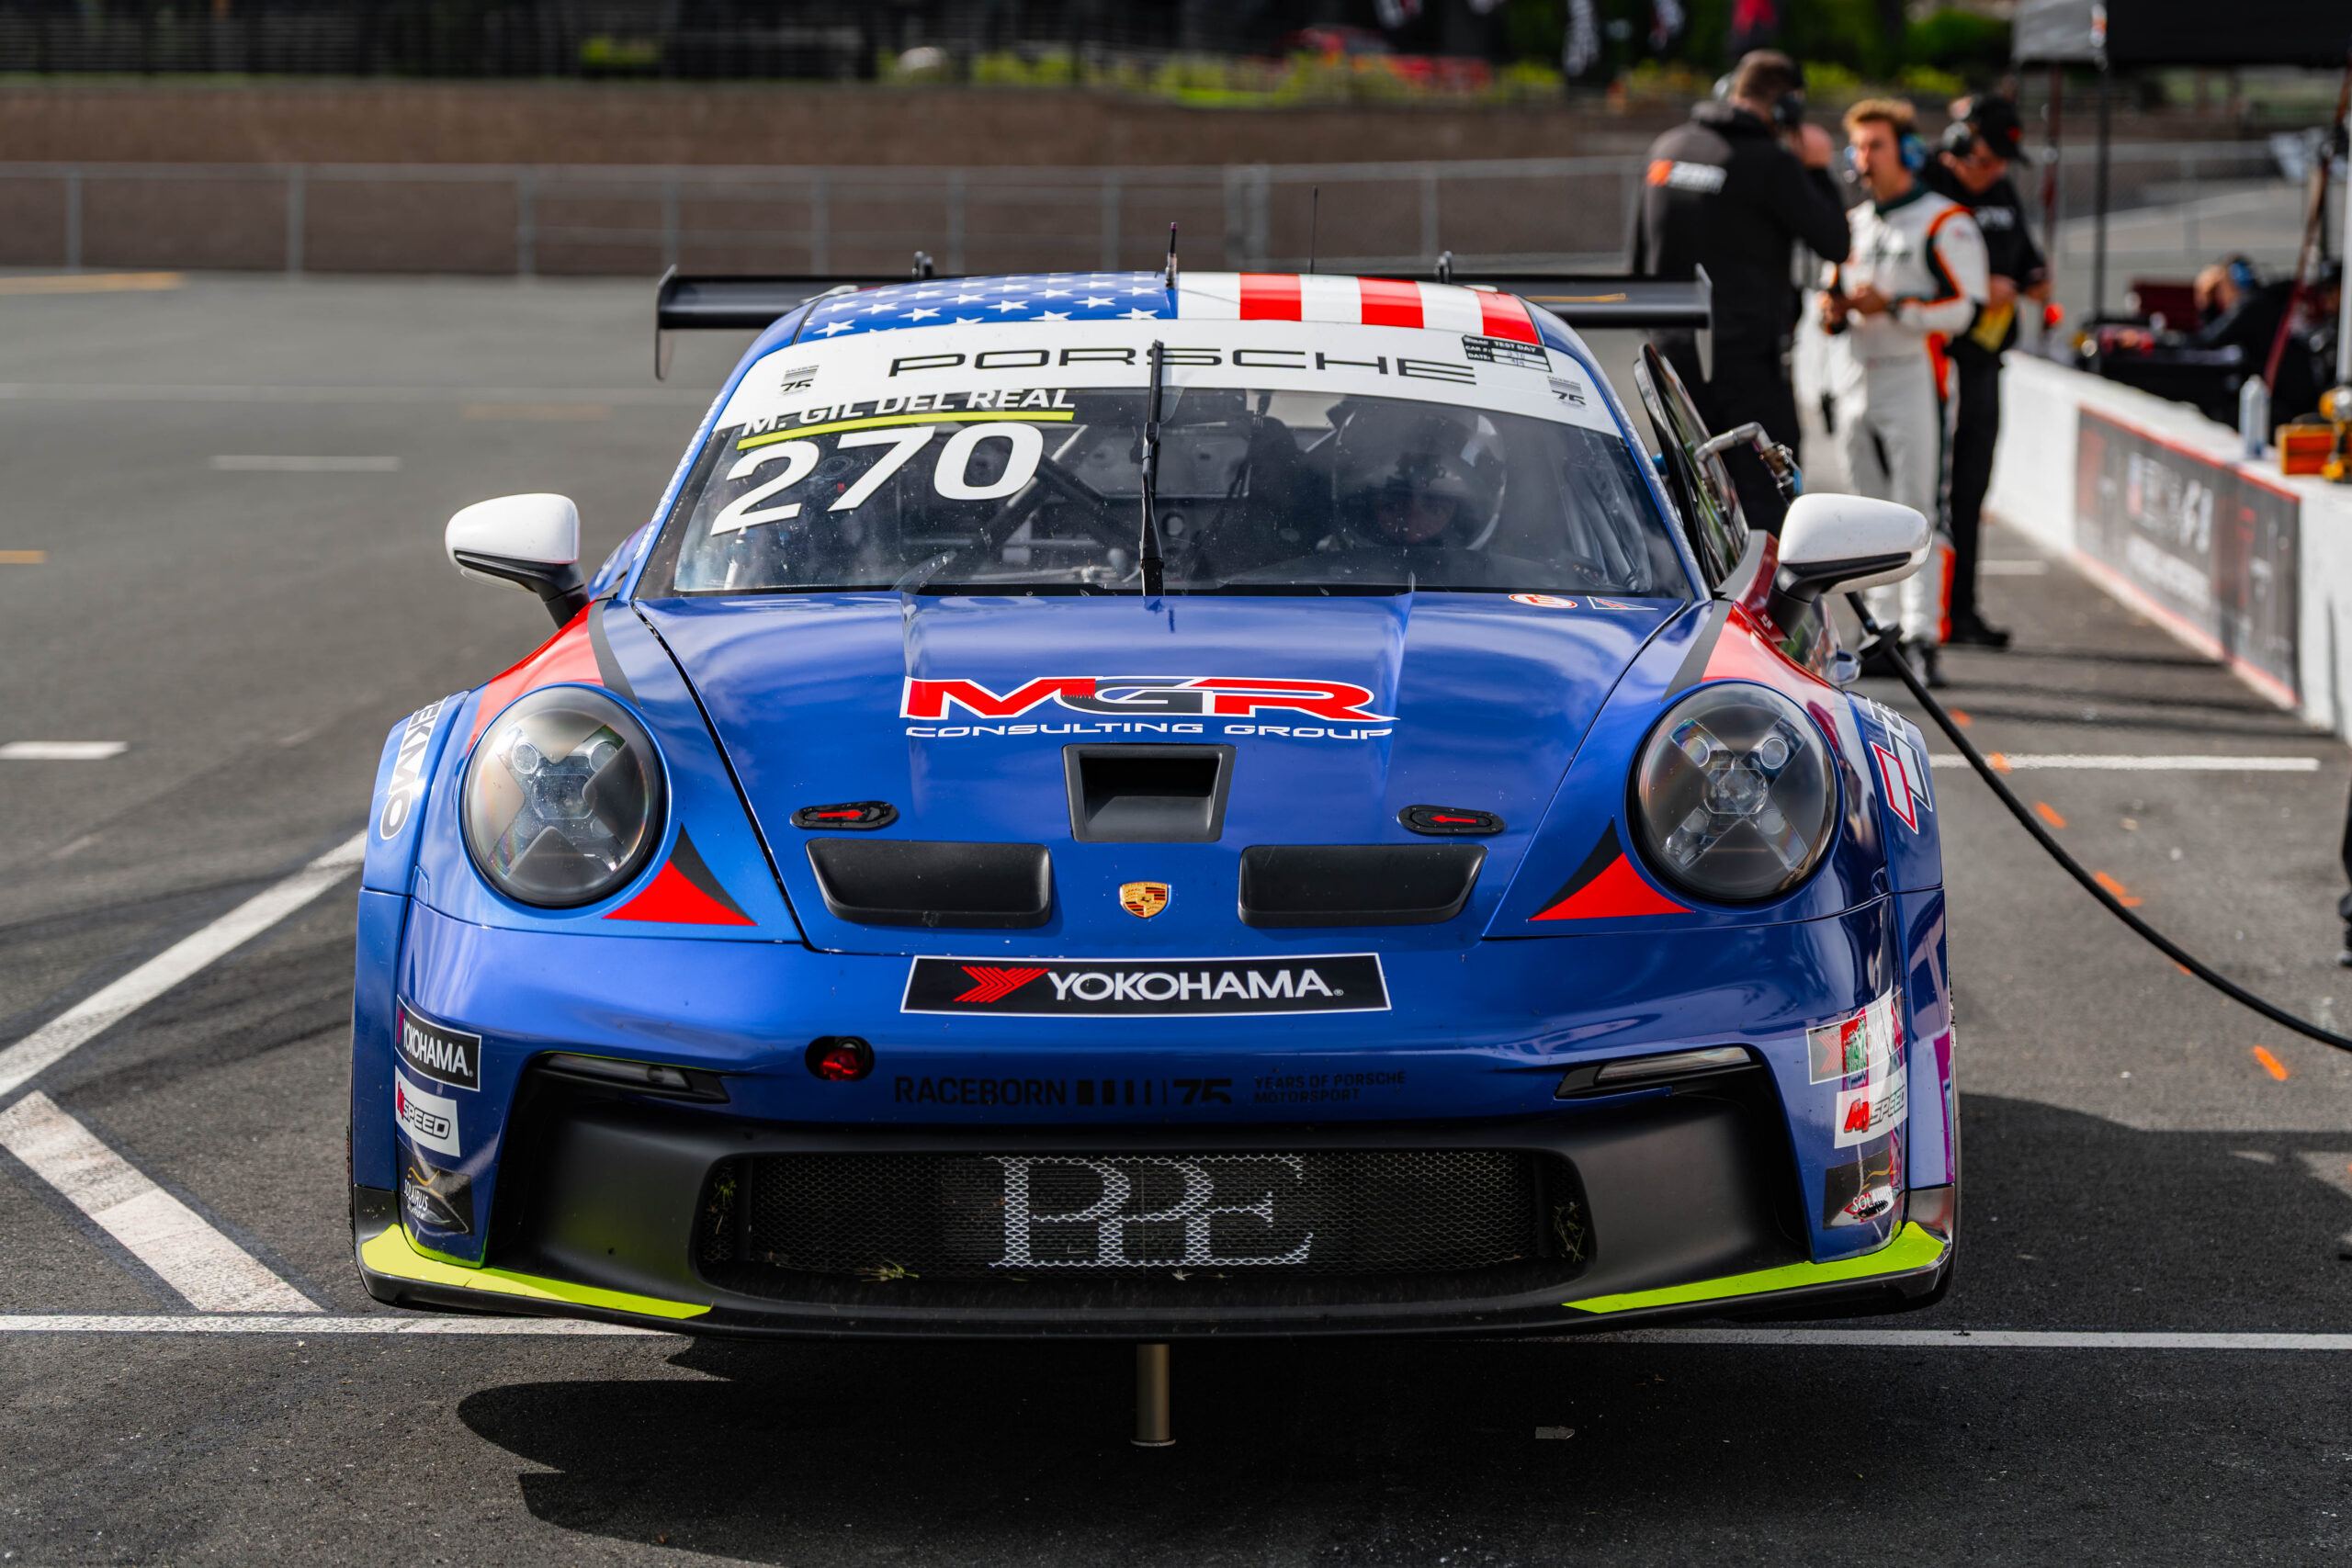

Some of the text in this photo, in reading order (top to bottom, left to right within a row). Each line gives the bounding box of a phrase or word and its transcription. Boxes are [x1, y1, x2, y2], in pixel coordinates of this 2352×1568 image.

[1493, 341, 1515, 349] TEST
[1517, 344, 1536, 353] DAY
[888, 347, 1477, 386] PORSCHE
[741, 389, 1076, 437] M. GIL DEL REAL
[709, 422, 1044, 536] 270
[899, 676, 1401, 722] MGR
[906, 722, 1393, 740] CONSULTING GROUP
[379, 697, 445, 840] EKMO
[1047, 969, 1333, 1001] YOKOHAMA
[403, 1018, 469, 1077] YOKOHAMA
[894, 1076, 1232, 1106] RACEBORN 75
[1254, 1070, 1406, 1090] YEARS OF PORSCHE
[1254, 1089, 1360, 1104] MOTORSPORT
